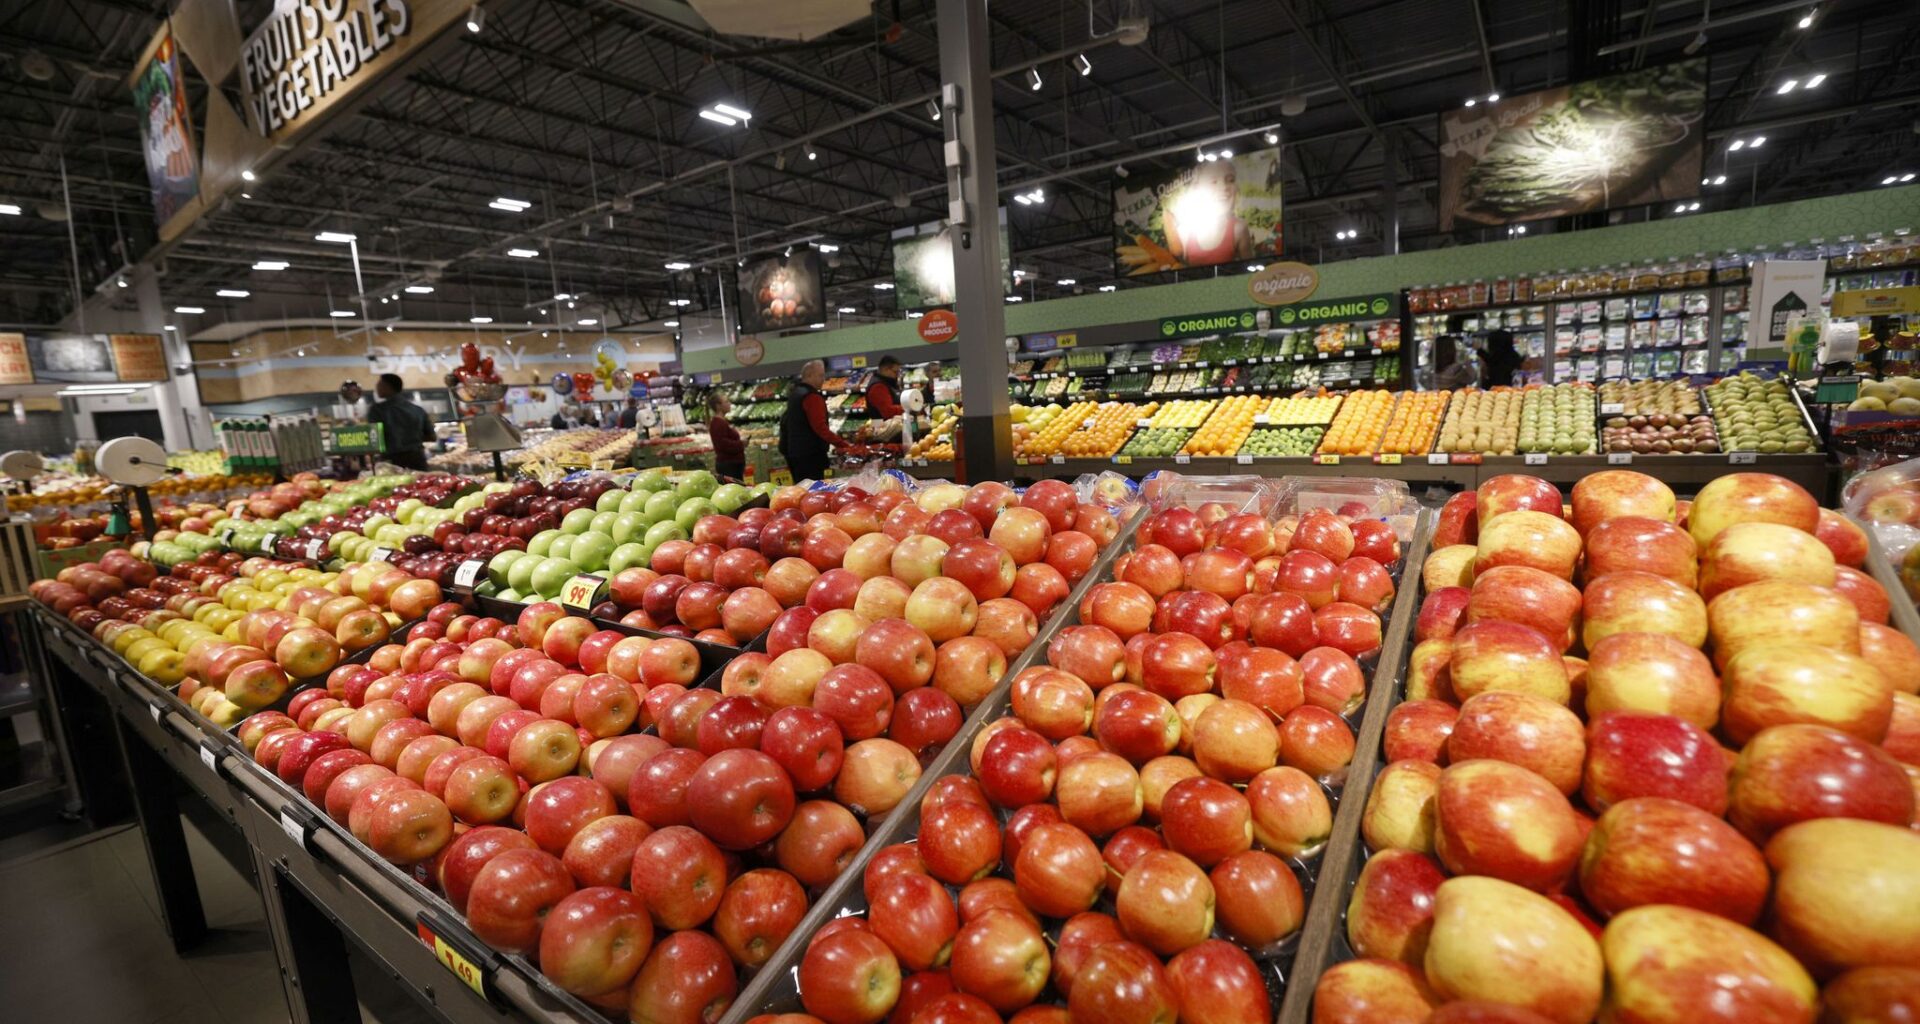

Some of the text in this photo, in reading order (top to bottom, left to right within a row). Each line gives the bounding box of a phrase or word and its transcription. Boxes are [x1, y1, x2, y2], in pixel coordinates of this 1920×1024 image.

[243, 0, 319, 93] FRUITS
[251, 0, 408, 137] VEGETABLES
[1499, 96, 1543, 128] Local
[1119, 195, 1152, 219] TEXAS
[1254, 274, 1313, 296] organic
[1299, 302, 1368, 320] ORGANIC
[924, 327, 953, 336] PRODUCE
[928, 320, 948, 329] ASIAN
[1179, 316, 1238, 333] ORGANIC
[338, 431, 370, 448] ORGANIC
